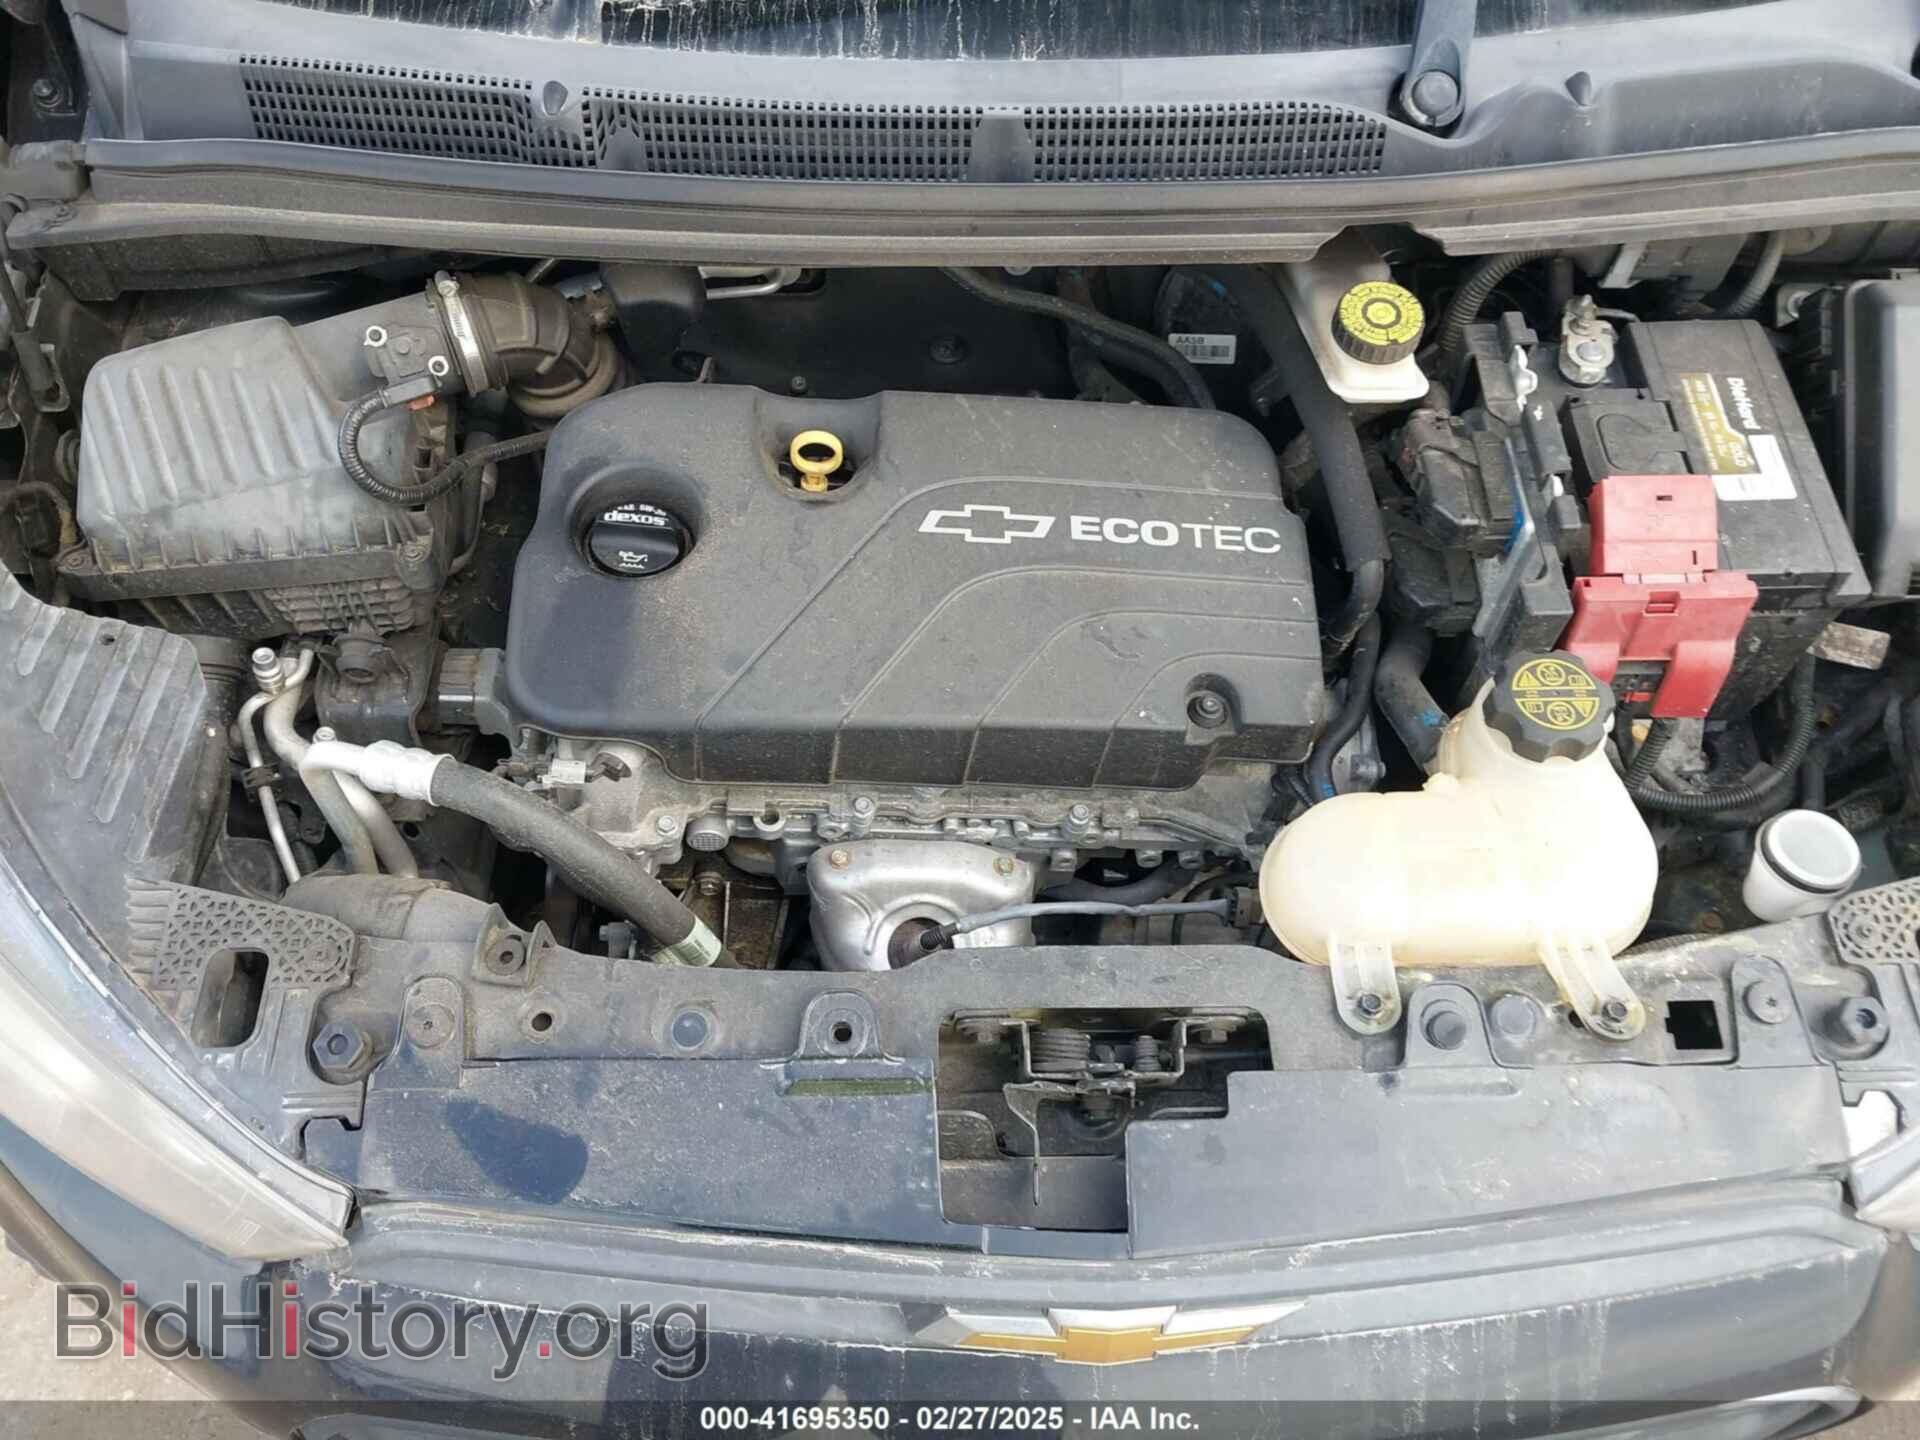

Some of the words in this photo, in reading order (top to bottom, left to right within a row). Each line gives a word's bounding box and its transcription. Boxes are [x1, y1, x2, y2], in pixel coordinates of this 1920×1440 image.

[1727, 377, 1761, 430] DieHard
[604, 510, 665, 526] dexos
[1070, 515, 1281, 554] ECOTEC
